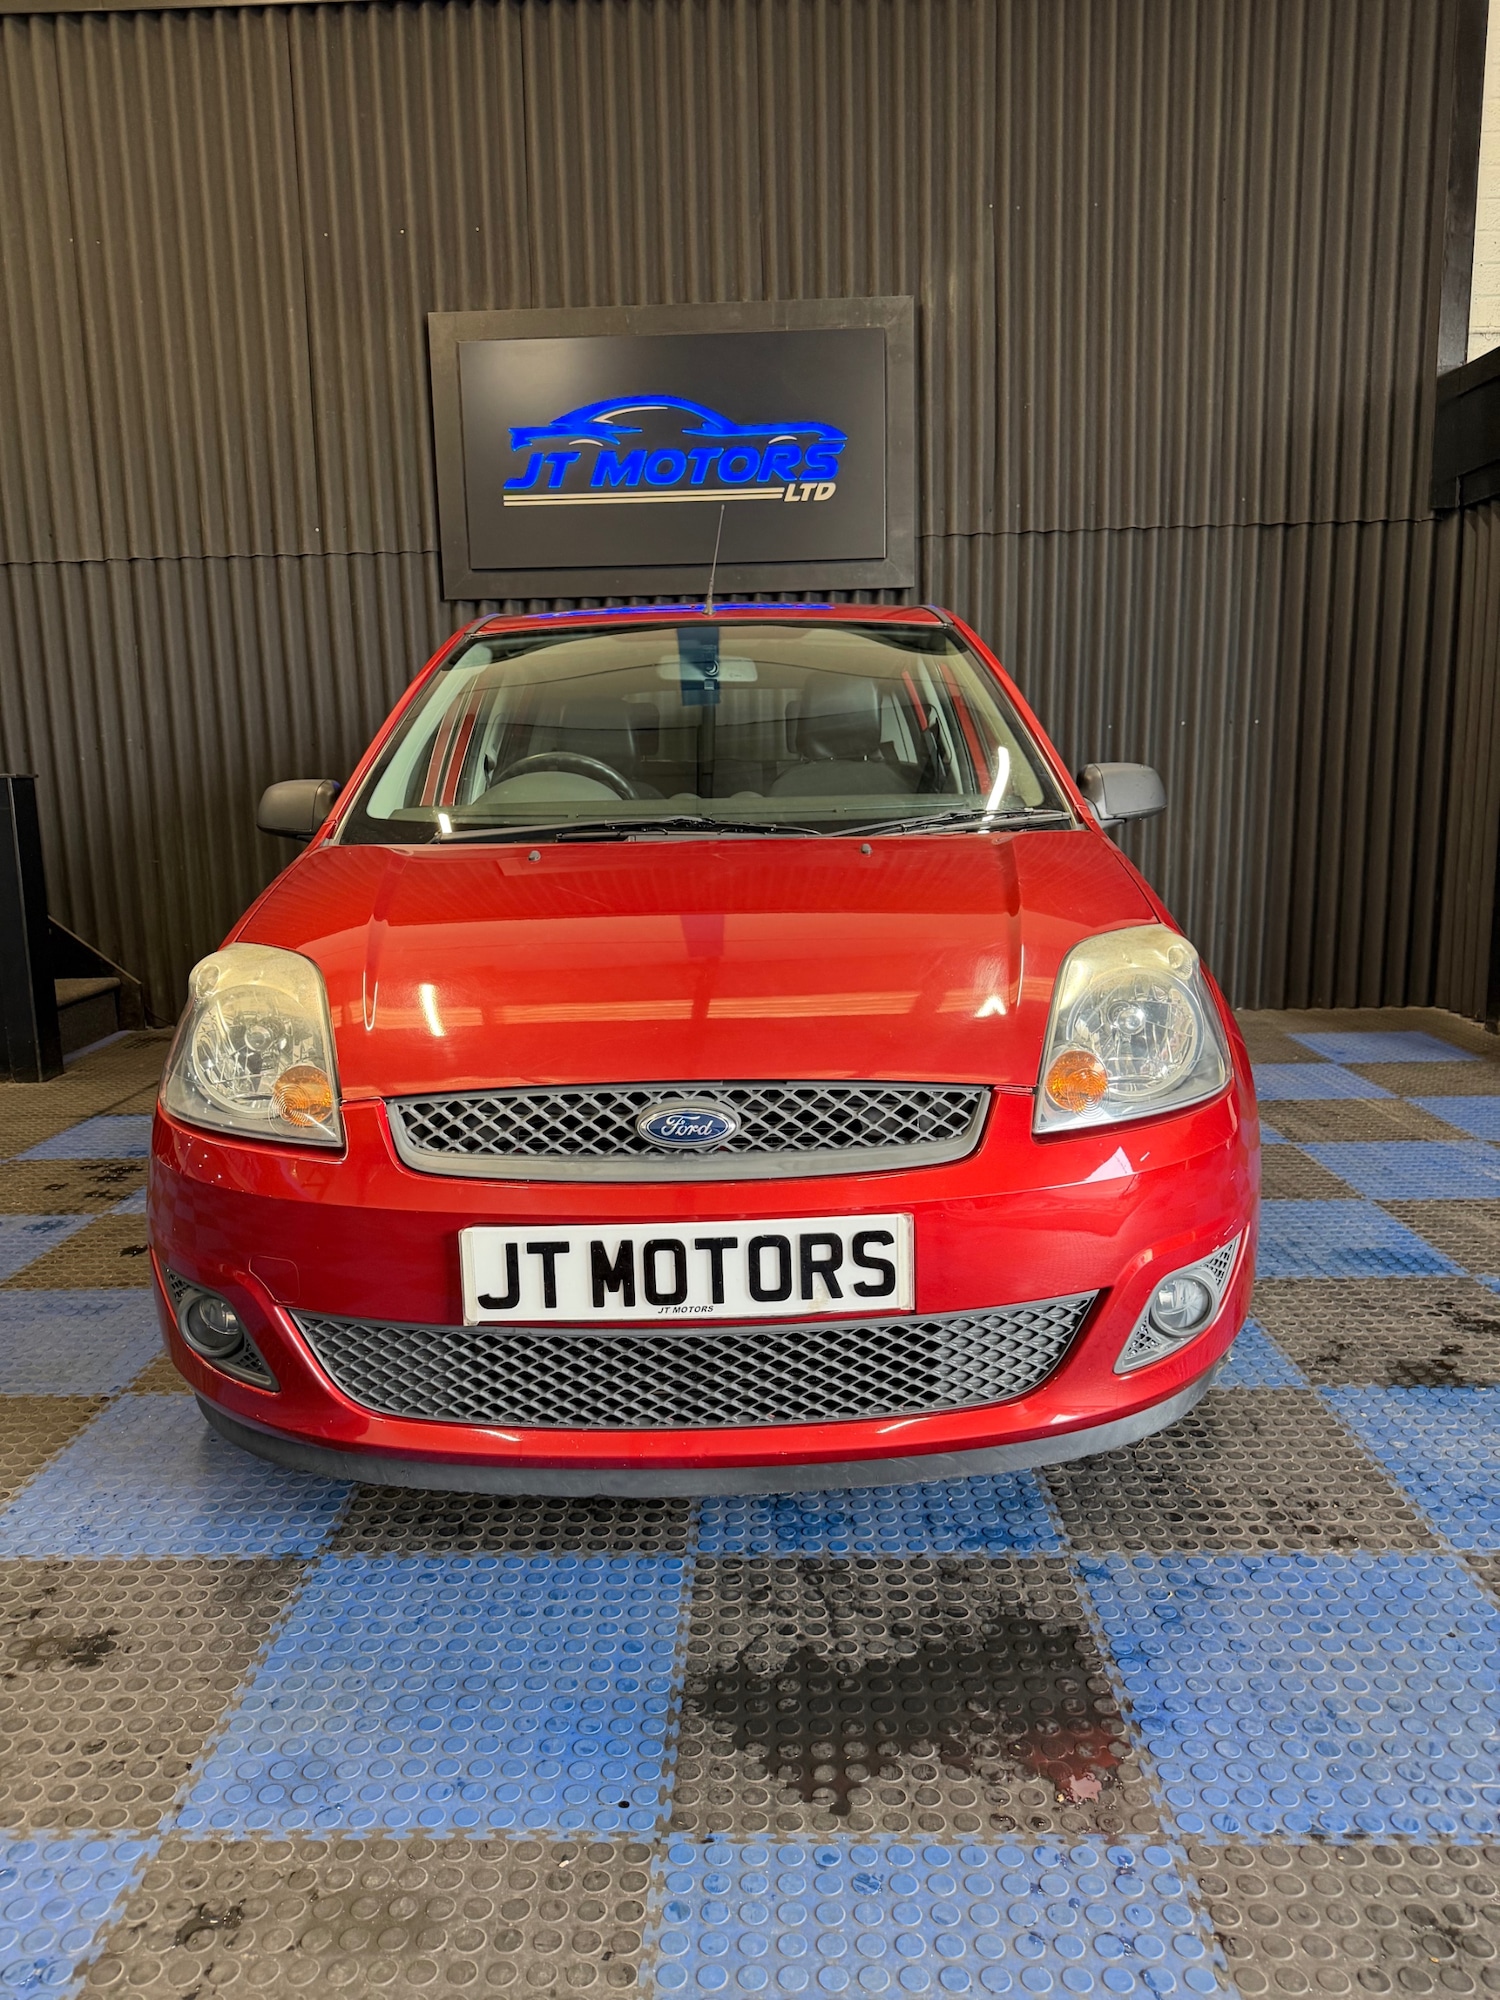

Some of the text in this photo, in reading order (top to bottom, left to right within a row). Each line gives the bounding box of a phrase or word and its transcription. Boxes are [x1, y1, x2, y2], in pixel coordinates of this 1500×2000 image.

[503, 443, 846, 489] JT MOTORS
[783, 482, 836, 502] LTD
[660, 1114, 714, 1137] Ford
[477, 1229, 897, 1310] JT MOTORS
[657, 1305, 715, 1314] JT MOTORS
